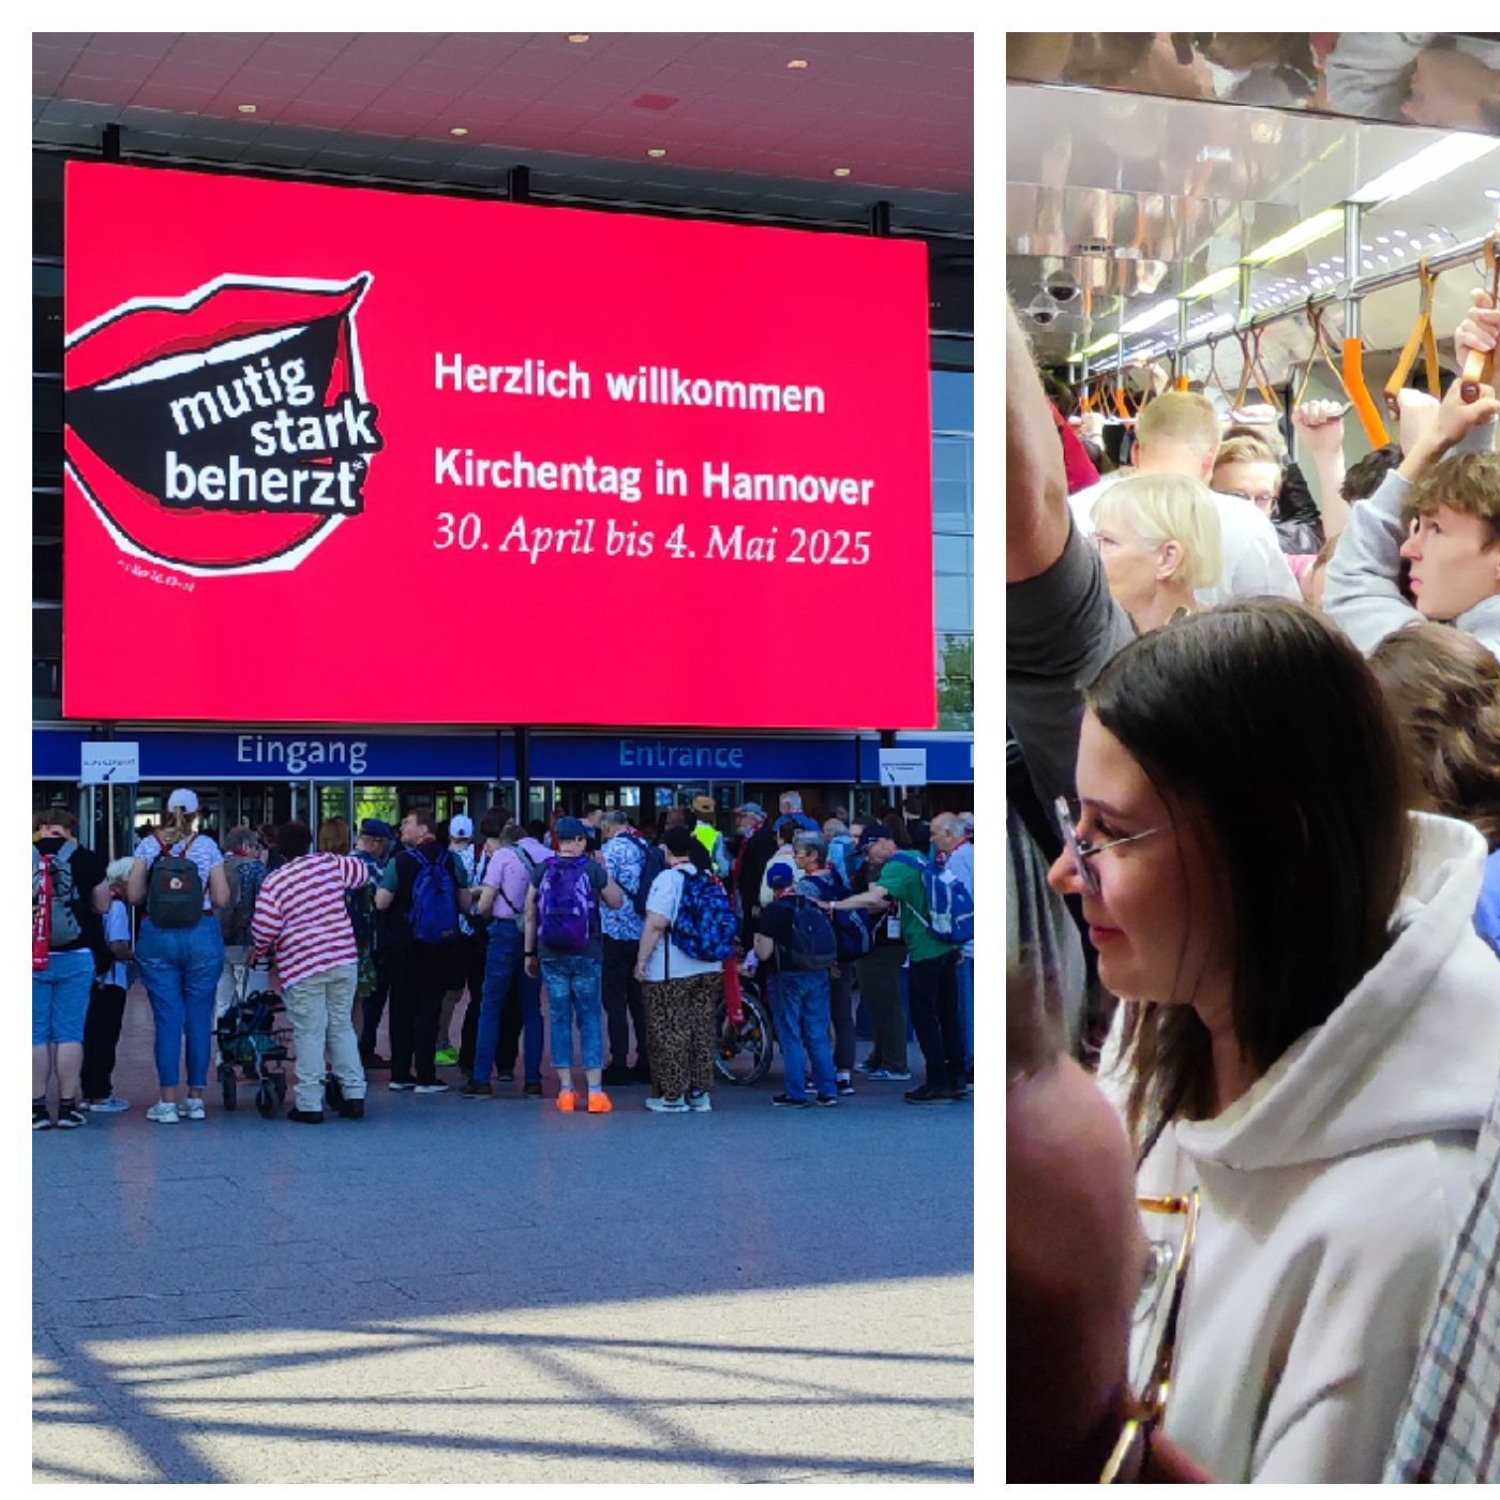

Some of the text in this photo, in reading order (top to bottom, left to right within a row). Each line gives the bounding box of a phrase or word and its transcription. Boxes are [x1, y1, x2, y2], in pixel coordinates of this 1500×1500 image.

[169, 356, 316, 435] mutig
[434, 352, 825, 413] Herzlich willkommen
[251, 400, 378, 456] stark
[434, 447, 875, 505] Kirchentag in Hannover
[432, 511, 872, 565] 30. April bis 4. Mai 2025
[238, 735, 368, 774] Eingang
[619, 740, 745, 769] Entrance
